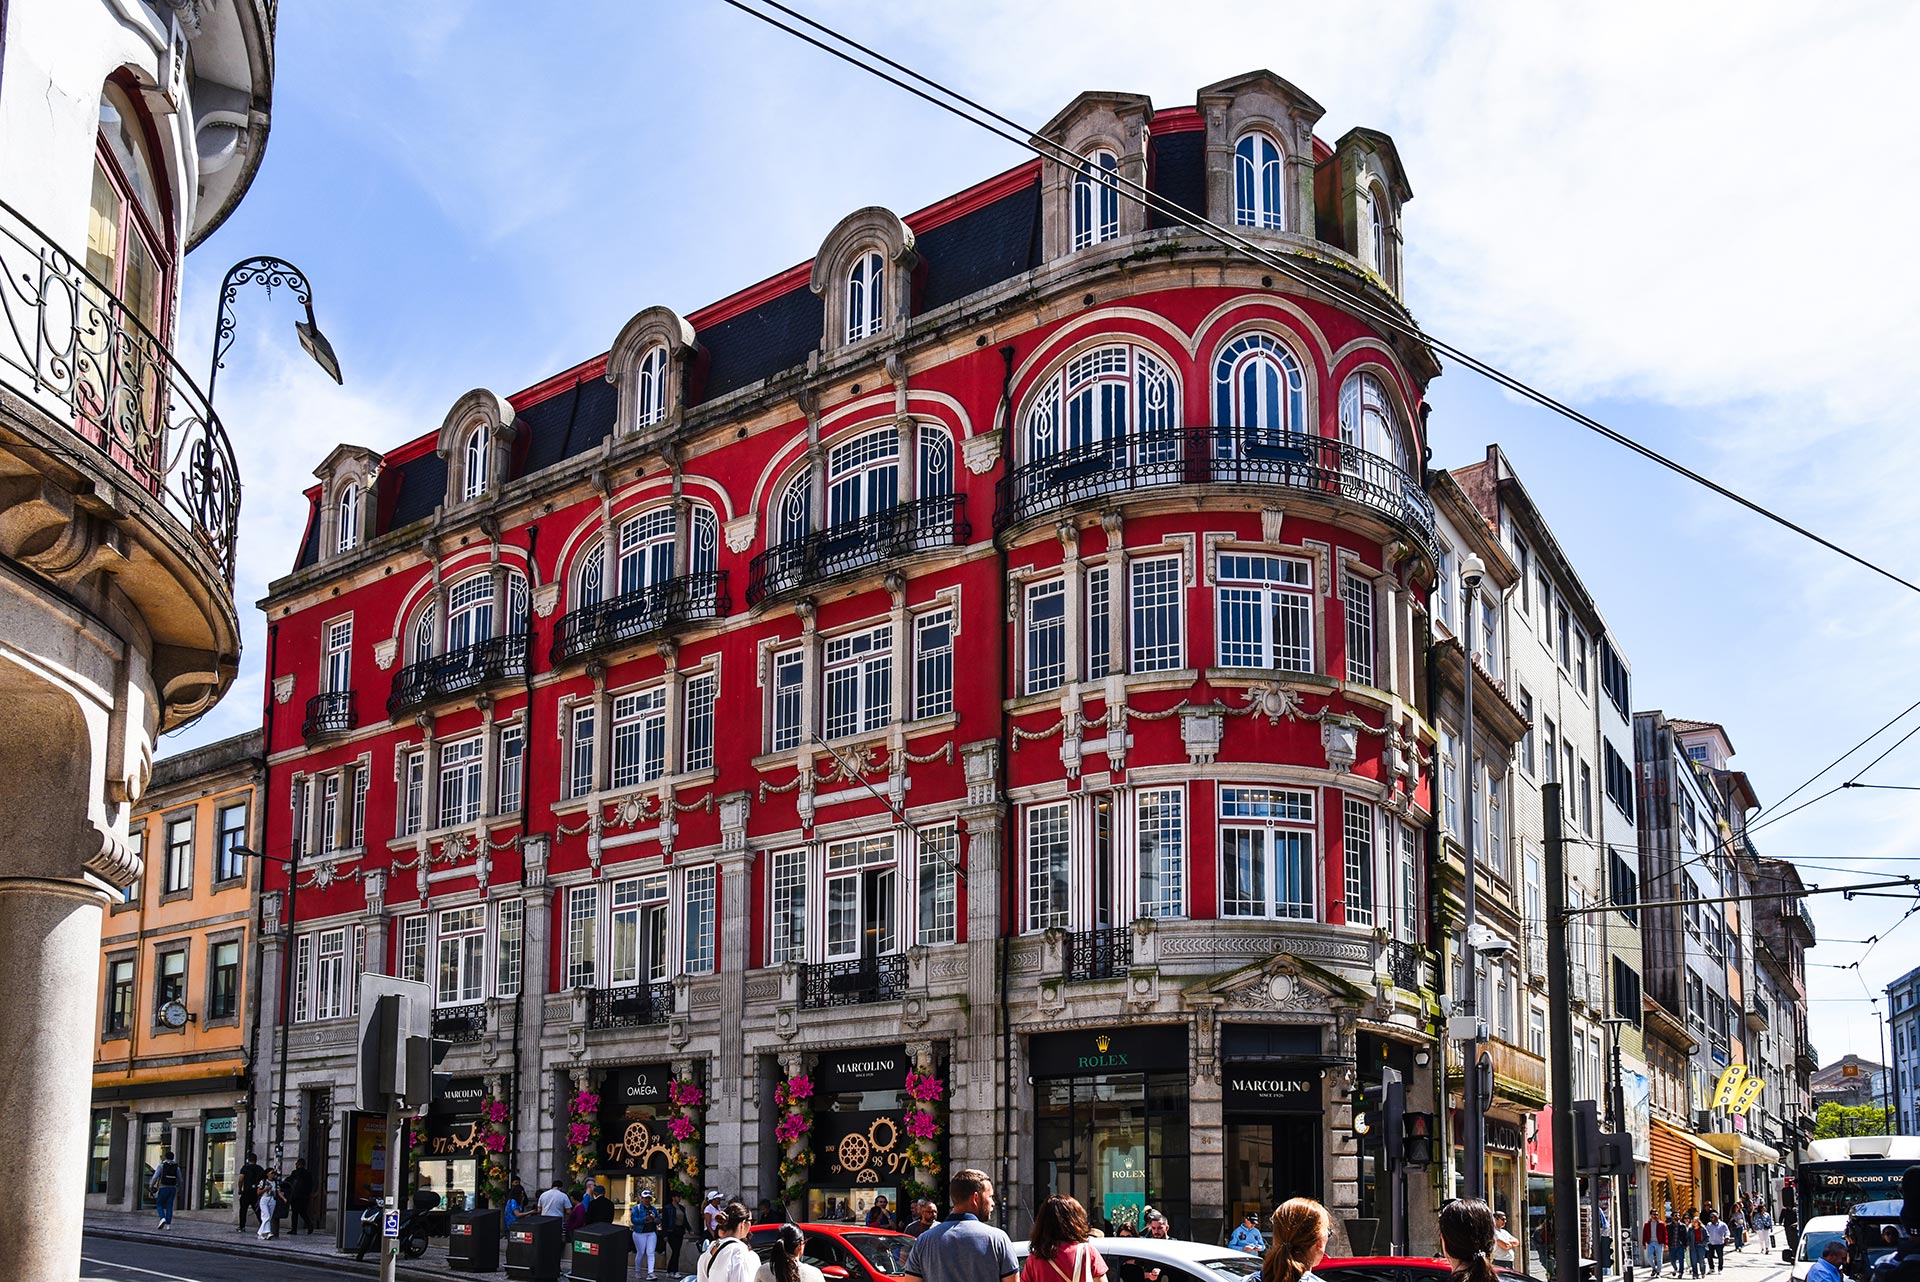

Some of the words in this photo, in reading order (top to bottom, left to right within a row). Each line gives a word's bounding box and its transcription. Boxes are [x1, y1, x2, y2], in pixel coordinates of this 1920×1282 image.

[1079, 1054, 1128, 1067] ROLEX
[836, 1060, 894, 1073] MARCOLINO
[627, 1086, 657, 1096] OMEGA
[1720, 1067, 1740, 1104] OURO
[444, 1089, 483, 1099] MARCOLINO
[1733, 1080, 1758, 1112] OURO
[651, 1135, 660, 1143] 99
[433, 1137, 447, 1154] 97
[606, 1143, 624, 1162] 97
[625, 1158, 635, 1168] 98
[872, 1156, 883, 1167] 98
[887, 1153, 908, 1174] 97
[831, 1164, 841, 1174] 99
[1112, 1170, 1145, 1178] ROLEX
[1827, 1175, 1844, 1185] 207
[1847, 1175, 1884, 1183] MERCADO
